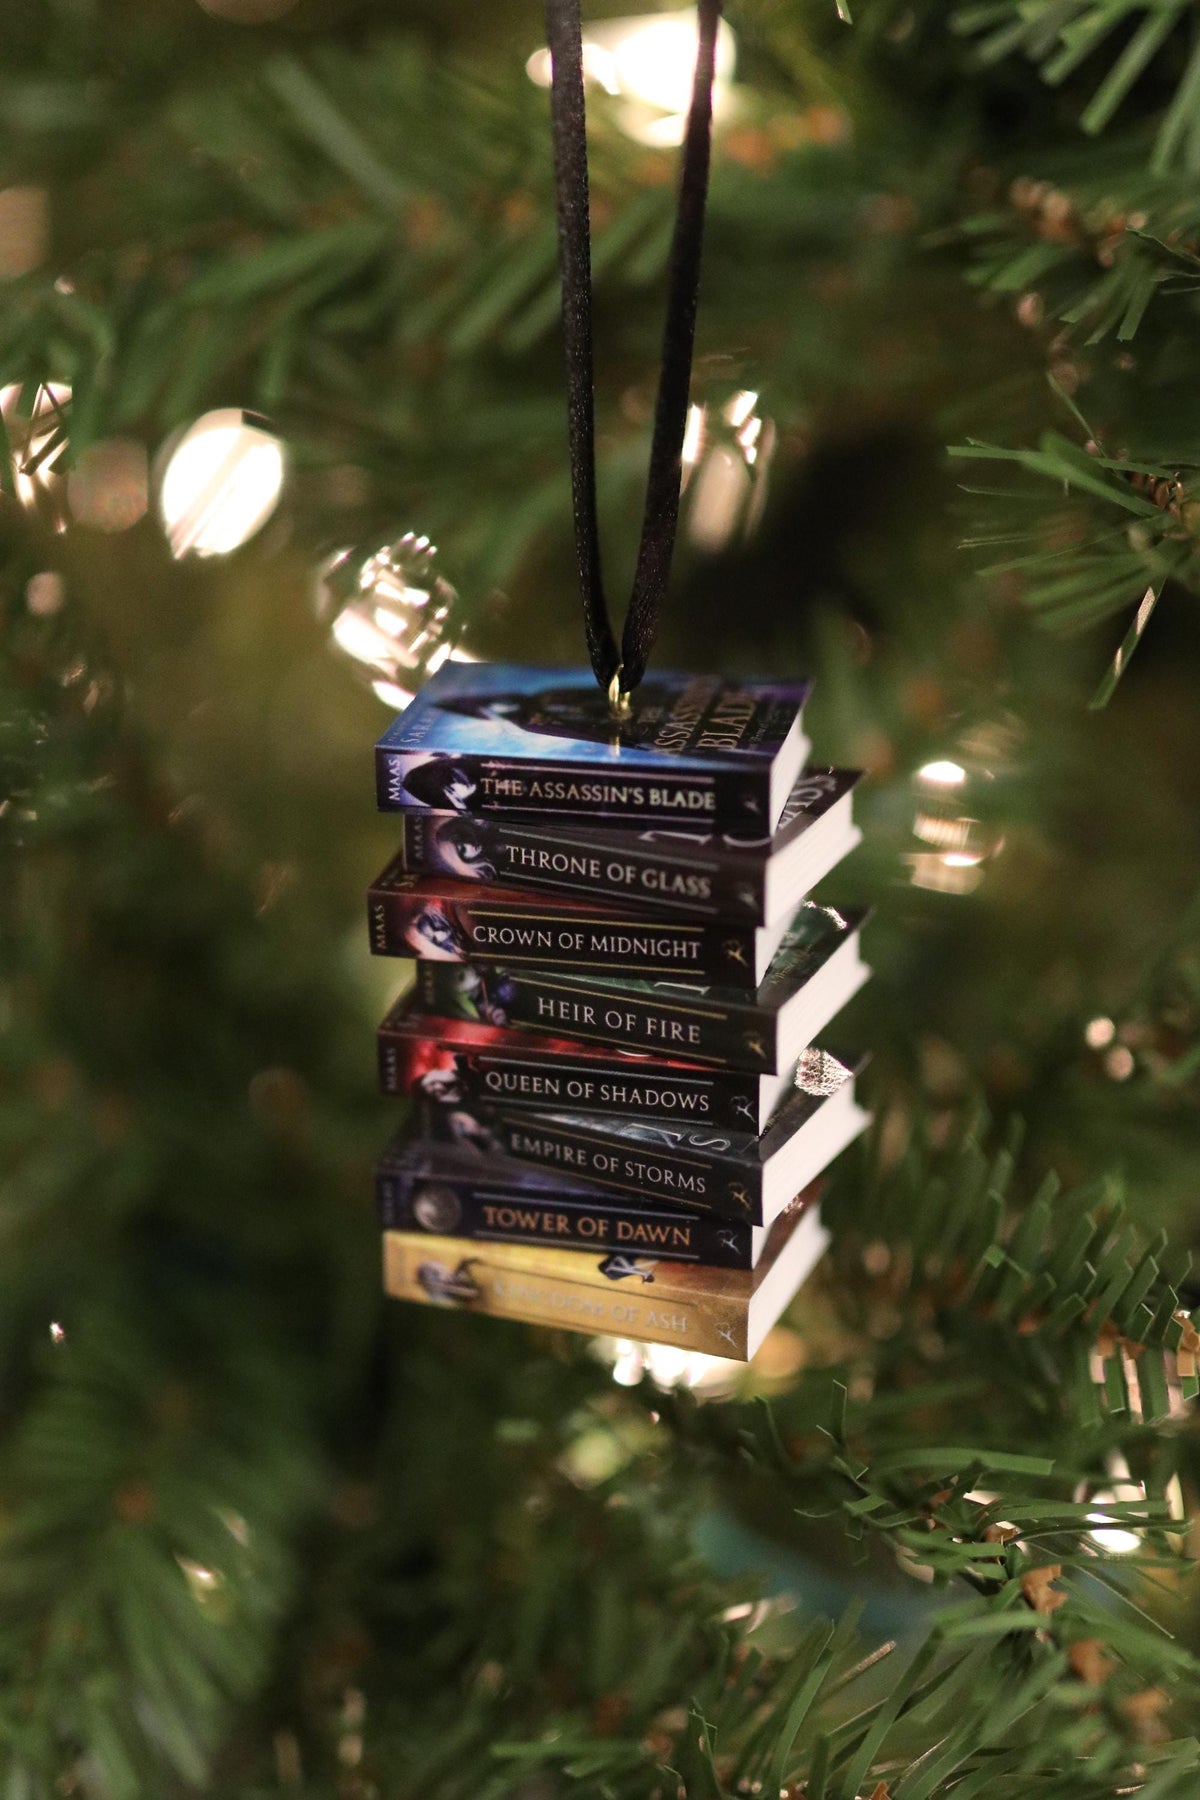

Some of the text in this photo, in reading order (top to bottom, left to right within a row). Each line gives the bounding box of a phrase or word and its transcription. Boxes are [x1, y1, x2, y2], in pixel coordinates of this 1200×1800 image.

[388, 757, 401, 801] MAAS
[480, 777, 717, 811] THE ASSASSIN'S BLADE
[505, 845, 712, 898] THRONE OF GLASS
[472, 925, 701, 960] CROWN OF MIDNIGHT
[537, 996, 702, 1044] HEIR OF FIRE
[485, 1071, 710, 1112] QUEEN OF SHADOWS
[510, 1132, 707, 1194] EMPIRE OF STORMS
[482, 1205, 692, 1247] TOWER OF DAWN
[610, 1303, 643, 1323] OF
[645, 1311, 689, 1334] ASH
